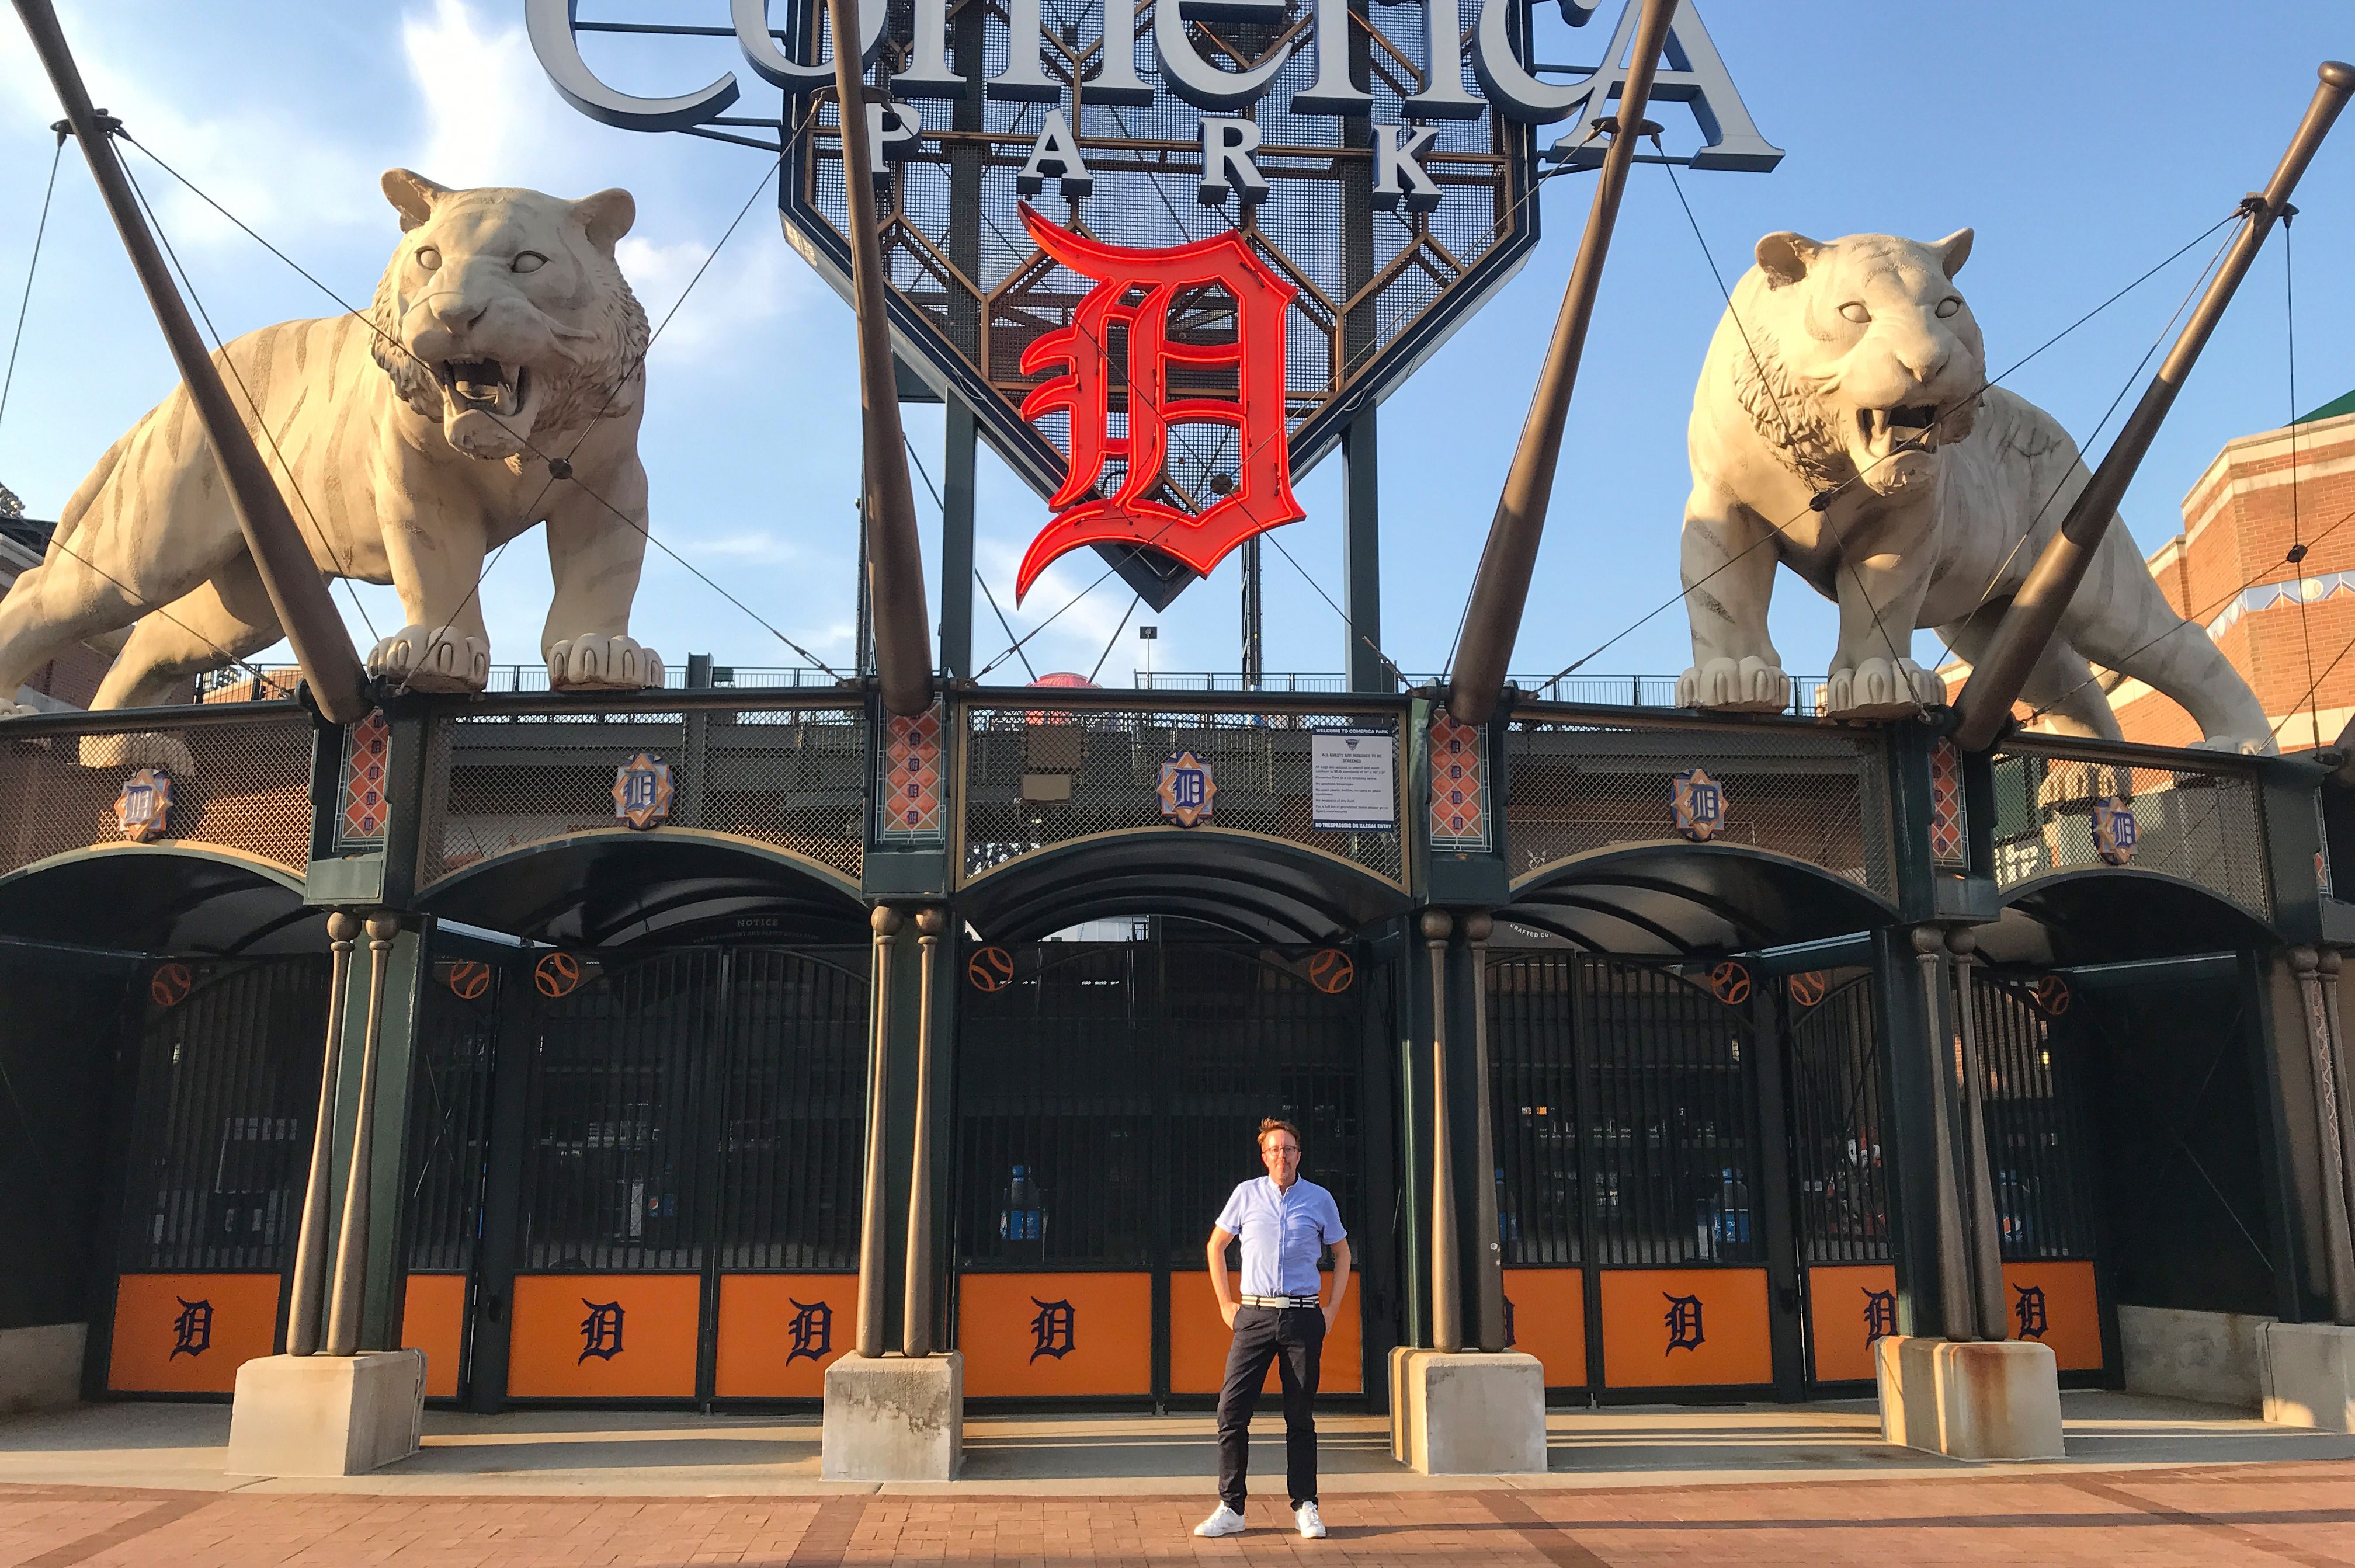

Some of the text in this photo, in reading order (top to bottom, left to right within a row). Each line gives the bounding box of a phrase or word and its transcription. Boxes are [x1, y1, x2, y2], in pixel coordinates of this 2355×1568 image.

[866, 102, 1444, 211] PARK
[737, 919, 778, 927] NOTICE
[1510, 924, 1538, 938] CRAFTED
